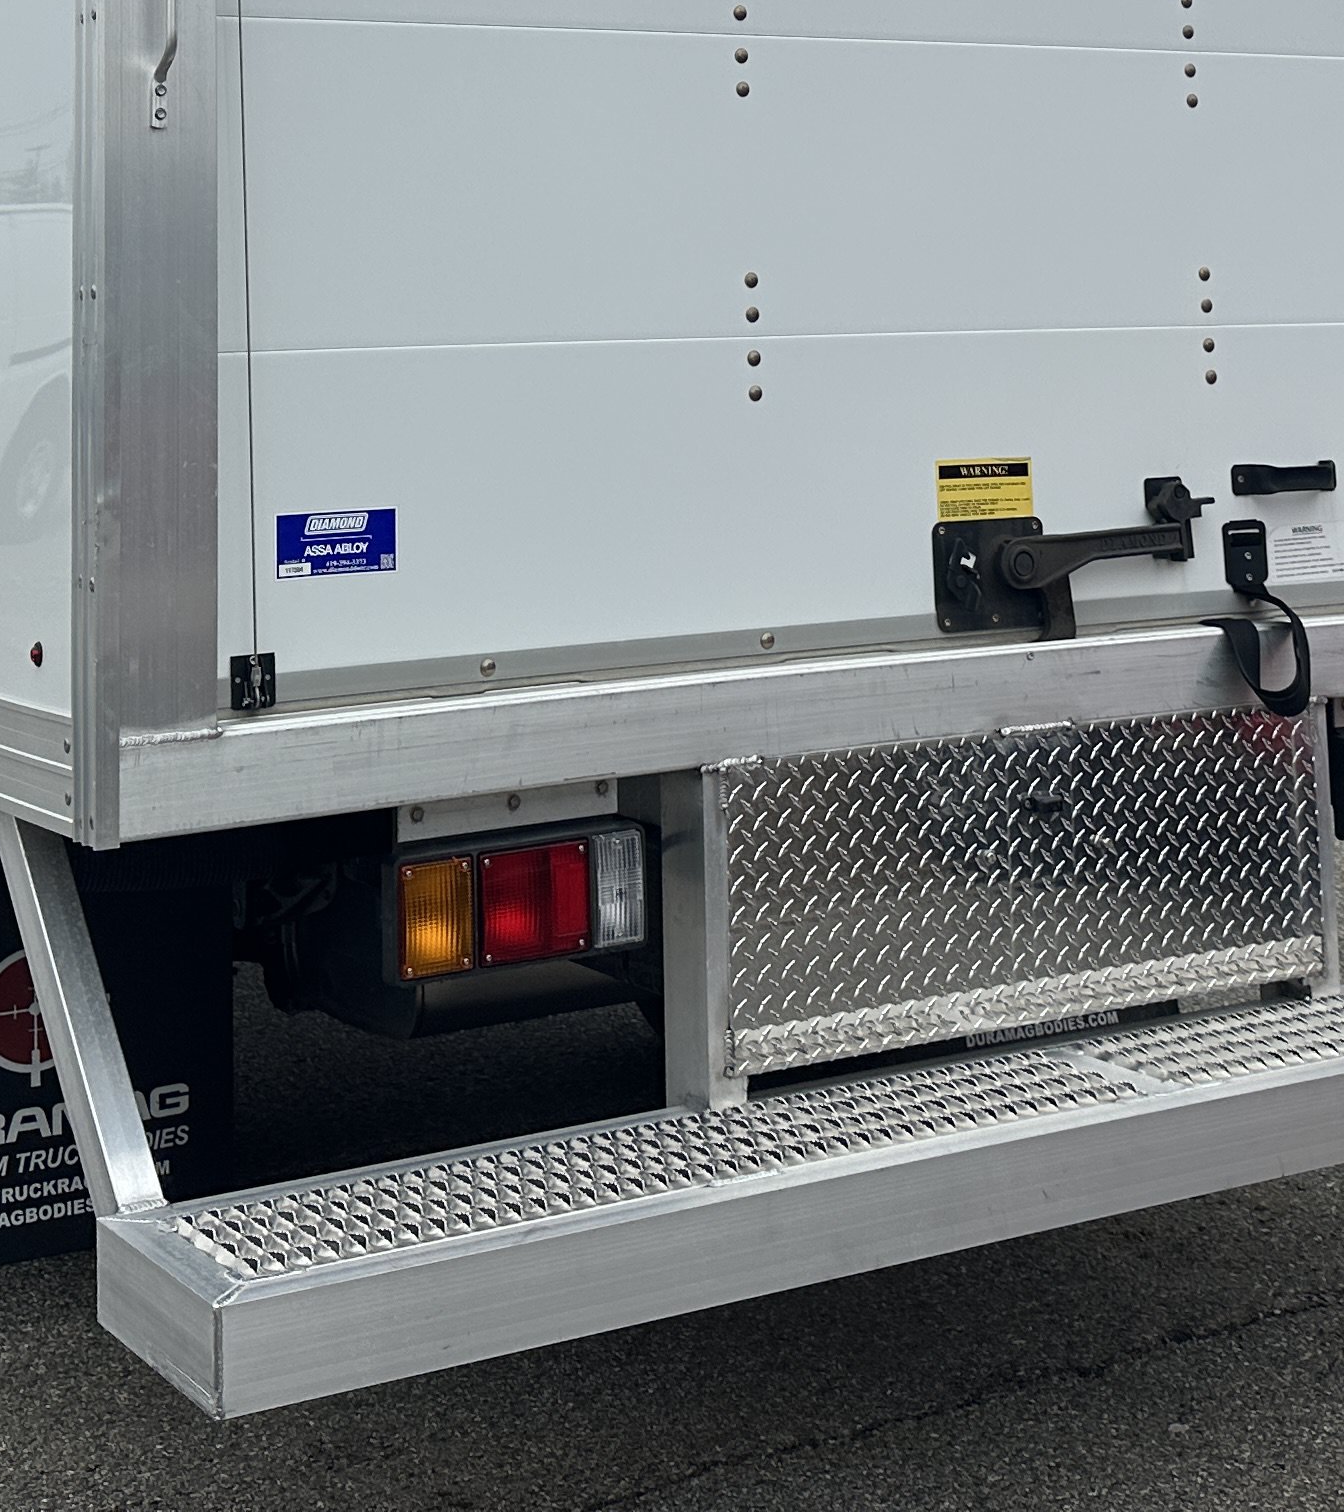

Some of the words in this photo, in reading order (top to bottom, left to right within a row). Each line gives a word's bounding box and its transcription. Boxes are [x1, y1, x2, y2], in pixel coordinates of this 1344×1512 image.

[309, 516, 364, 531] DIAMOND
[304, 544, 333, 557] ASSA
[334, 542, 369, 555] ABLOY
[965, 1010, 1120, 1048] DURAMAGBODIES.COM
[16, 1144, 80, 1174] TRUC
